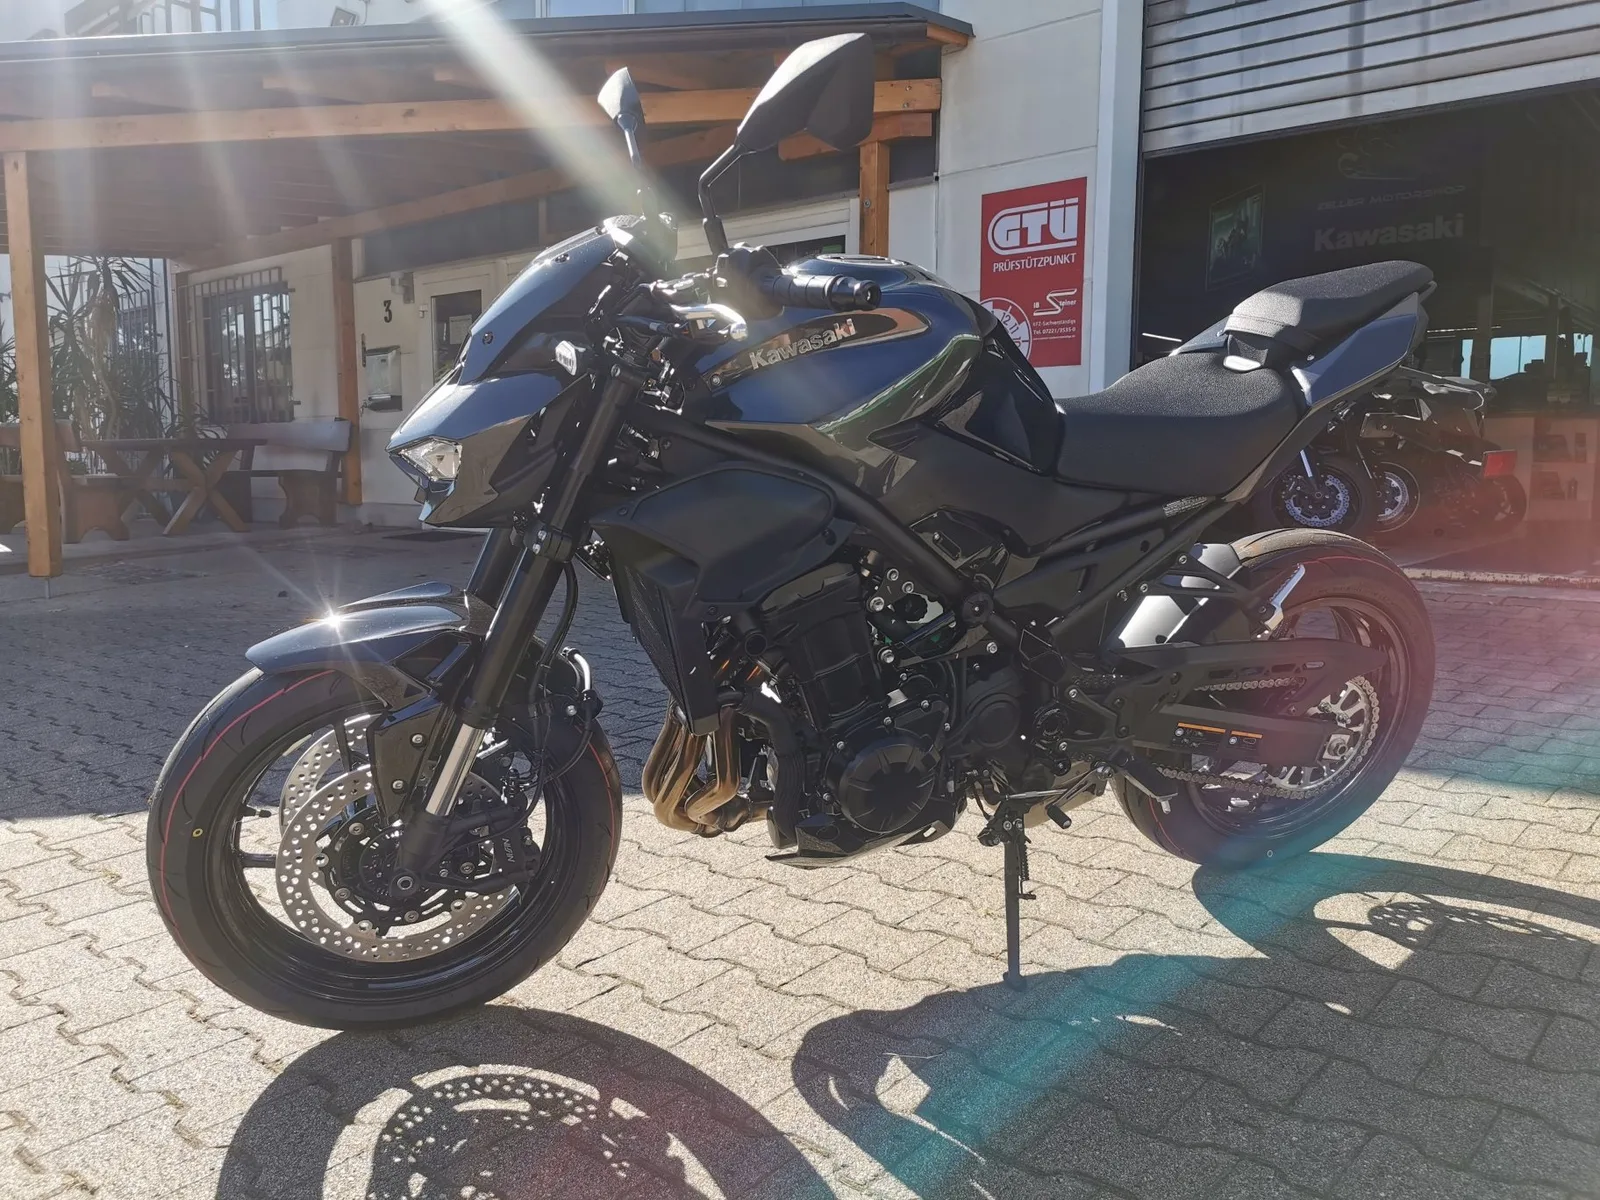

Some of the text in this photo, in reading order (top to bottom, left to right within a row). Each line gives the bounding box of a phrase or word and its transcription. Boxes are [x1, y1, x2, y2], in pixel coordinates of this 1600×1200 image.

[1369, 184, 1467, 206] MOTORSHOP
[988, 197, 1079, 256] GTÜ
[1314, 212, 1465, 252] Kawasaki
[993, 252, 1078, 273] PRÜFSTÜTZPUNKT
[383, 299, 393, 323] 3
[1000, 311, 1011, 326] 12
[1009, 322, 1020, 335] 11
[749, 318, 858, 370] Kawasaki
